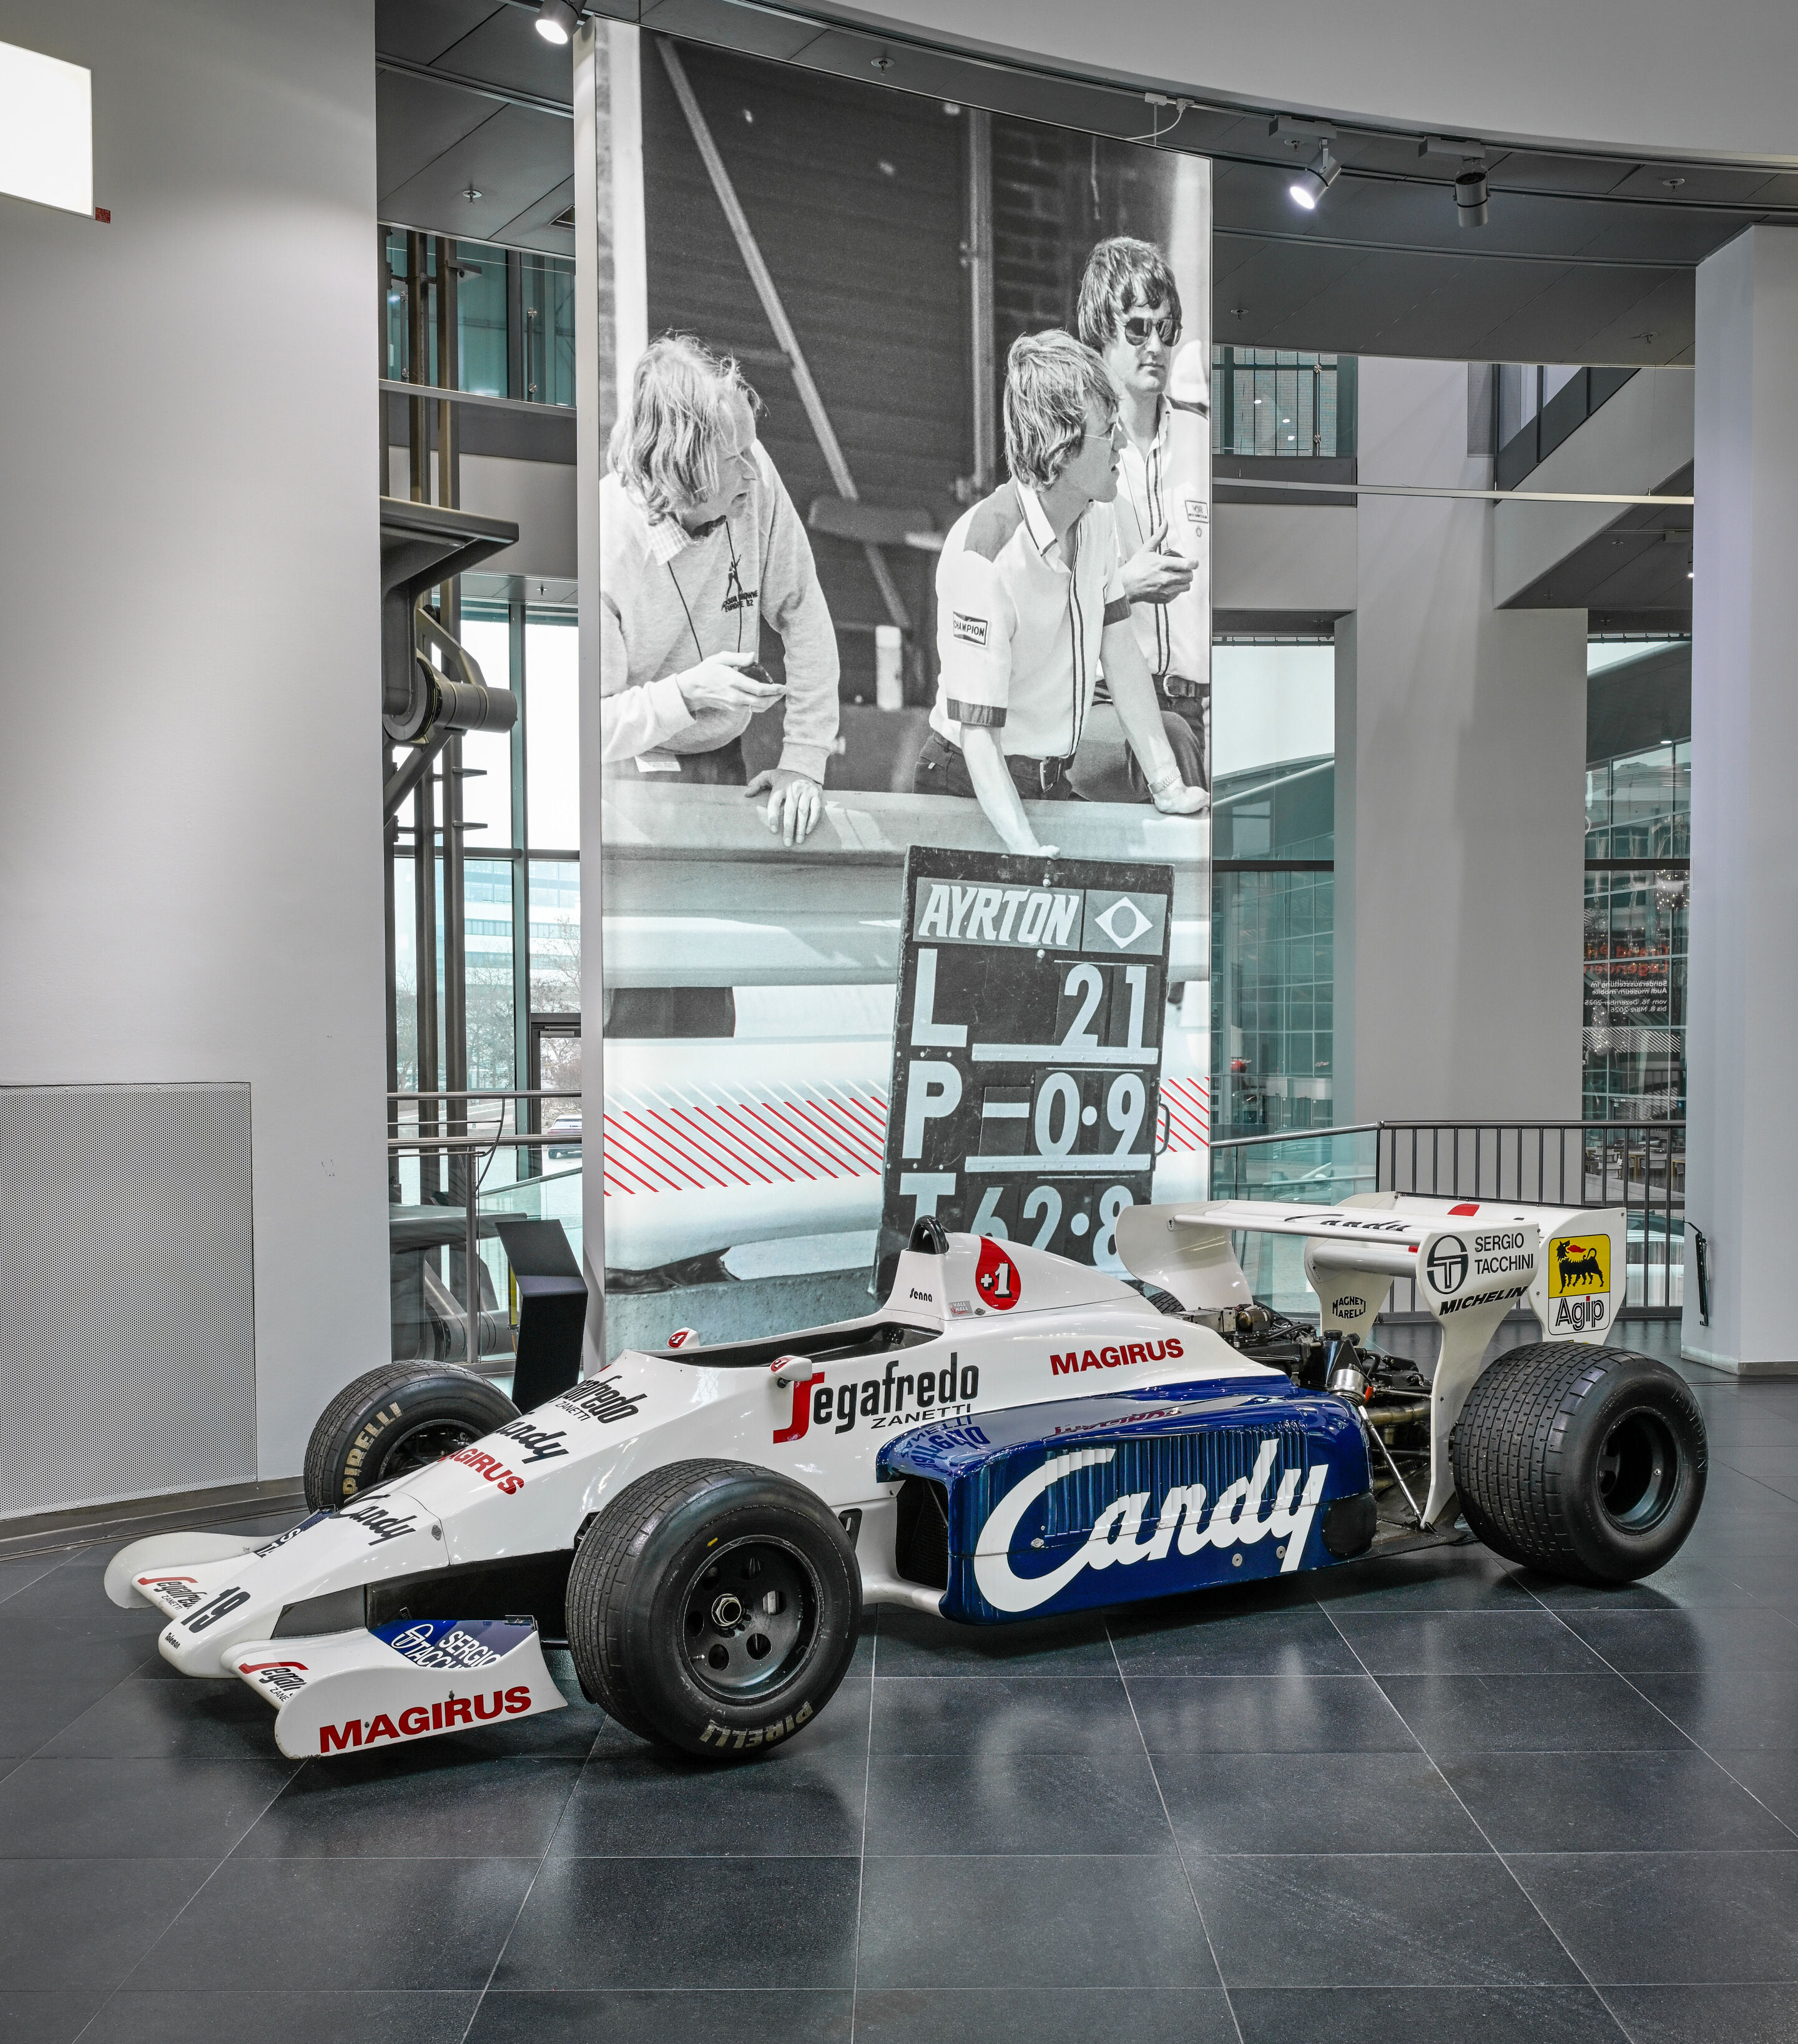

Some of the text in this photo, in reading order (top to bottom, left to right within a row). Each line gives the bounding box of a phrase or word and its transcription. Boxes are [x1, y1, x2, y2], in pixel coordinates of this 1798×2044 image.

[953, 620, 985, 637] CHAMPION
[918, 883, 1079, 946] AYRTON
[910, 948, 1147, 1049] L 21
[901, 1060, 962, 1159] P
[1475, 1232, 1525, 1252] SERGIO
[1475, 1254, 1534, 1275] TACCHINI
[910, 1287, 933, 1302] Senna
[1439, 1285, 1529, 1316] MICHELIN
[1555, 1295, 1604, 1331] Agip
[1049, 1338, 1184, 1376] MAGIRUS
[555, 1401, 591, 1422] ZANETTI
[773, 1352, 980, 1444] Segafredo
[871, 1403, 971, 1430] ZANETTI
[343, 1402, 403, 1495] PIRELLI
[494, 1412, 570, 1464] andy
[437, 1448, 524, 1495] GIRUS
[328, 1494, 418, 1546] Candy
[974, 1437, 1330, 1612] Candy
[161, 1595, 183, 1610] ZANETTI
[180, 1586, 251, 1633] 19
[164, 1632, 181, 1649] Toleman
[270, 1687, 290, 1702] ZANE
[320, 1686, 532, 1754] MAGIRUS
[699, 1700, 814, 1749] PIRELLI
